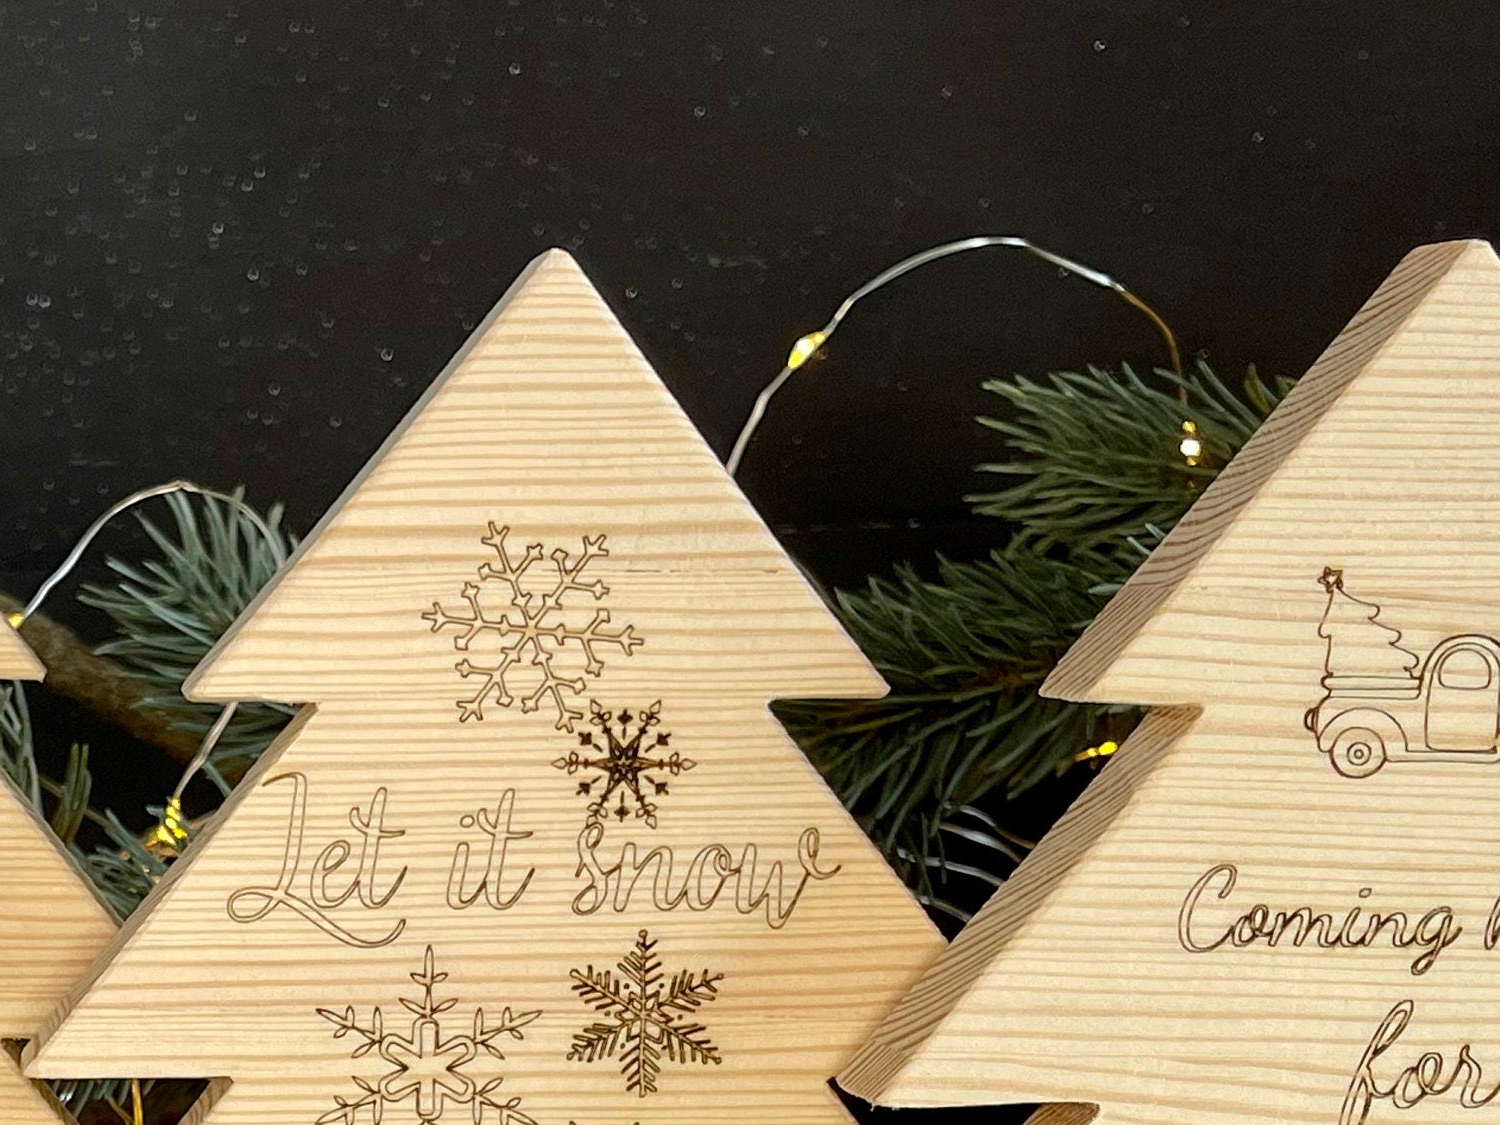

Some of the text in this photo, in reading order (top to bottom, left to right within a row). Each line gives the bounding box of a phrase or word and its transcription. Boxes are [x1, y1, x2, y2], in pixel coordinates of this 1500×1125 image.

[226, 771, 409, 950] Let
[445, 787, 537, 911] it
[1178, 863, 1462, 976] Coming
